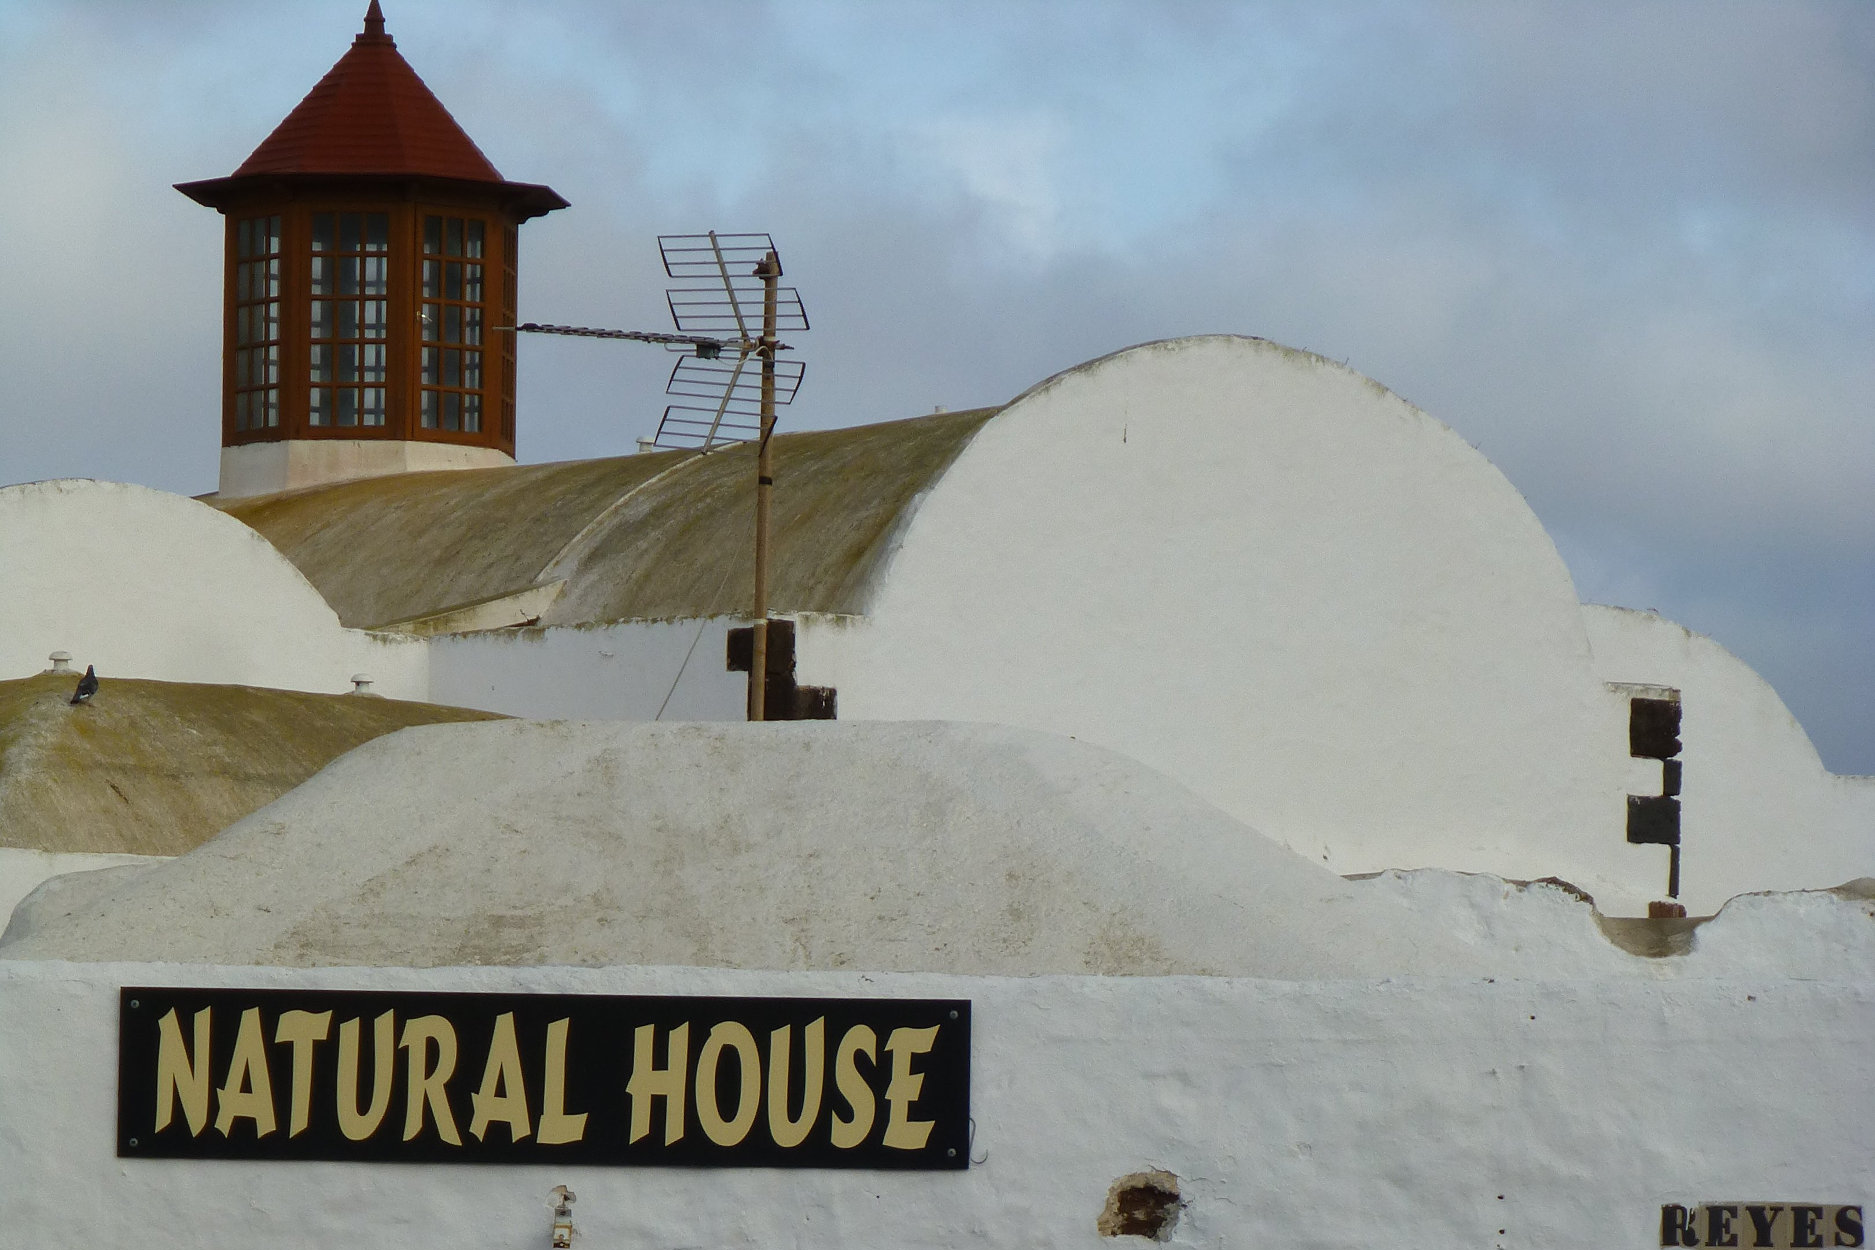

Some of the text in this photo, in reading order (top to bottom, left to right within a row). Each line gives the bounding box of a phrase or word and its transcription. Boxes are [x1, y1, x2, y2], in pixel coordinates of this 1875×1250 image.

[155, 1006, 941, 1151] NATURAL HOUSE
[1661, 1204, 1864, 1248] REYES
